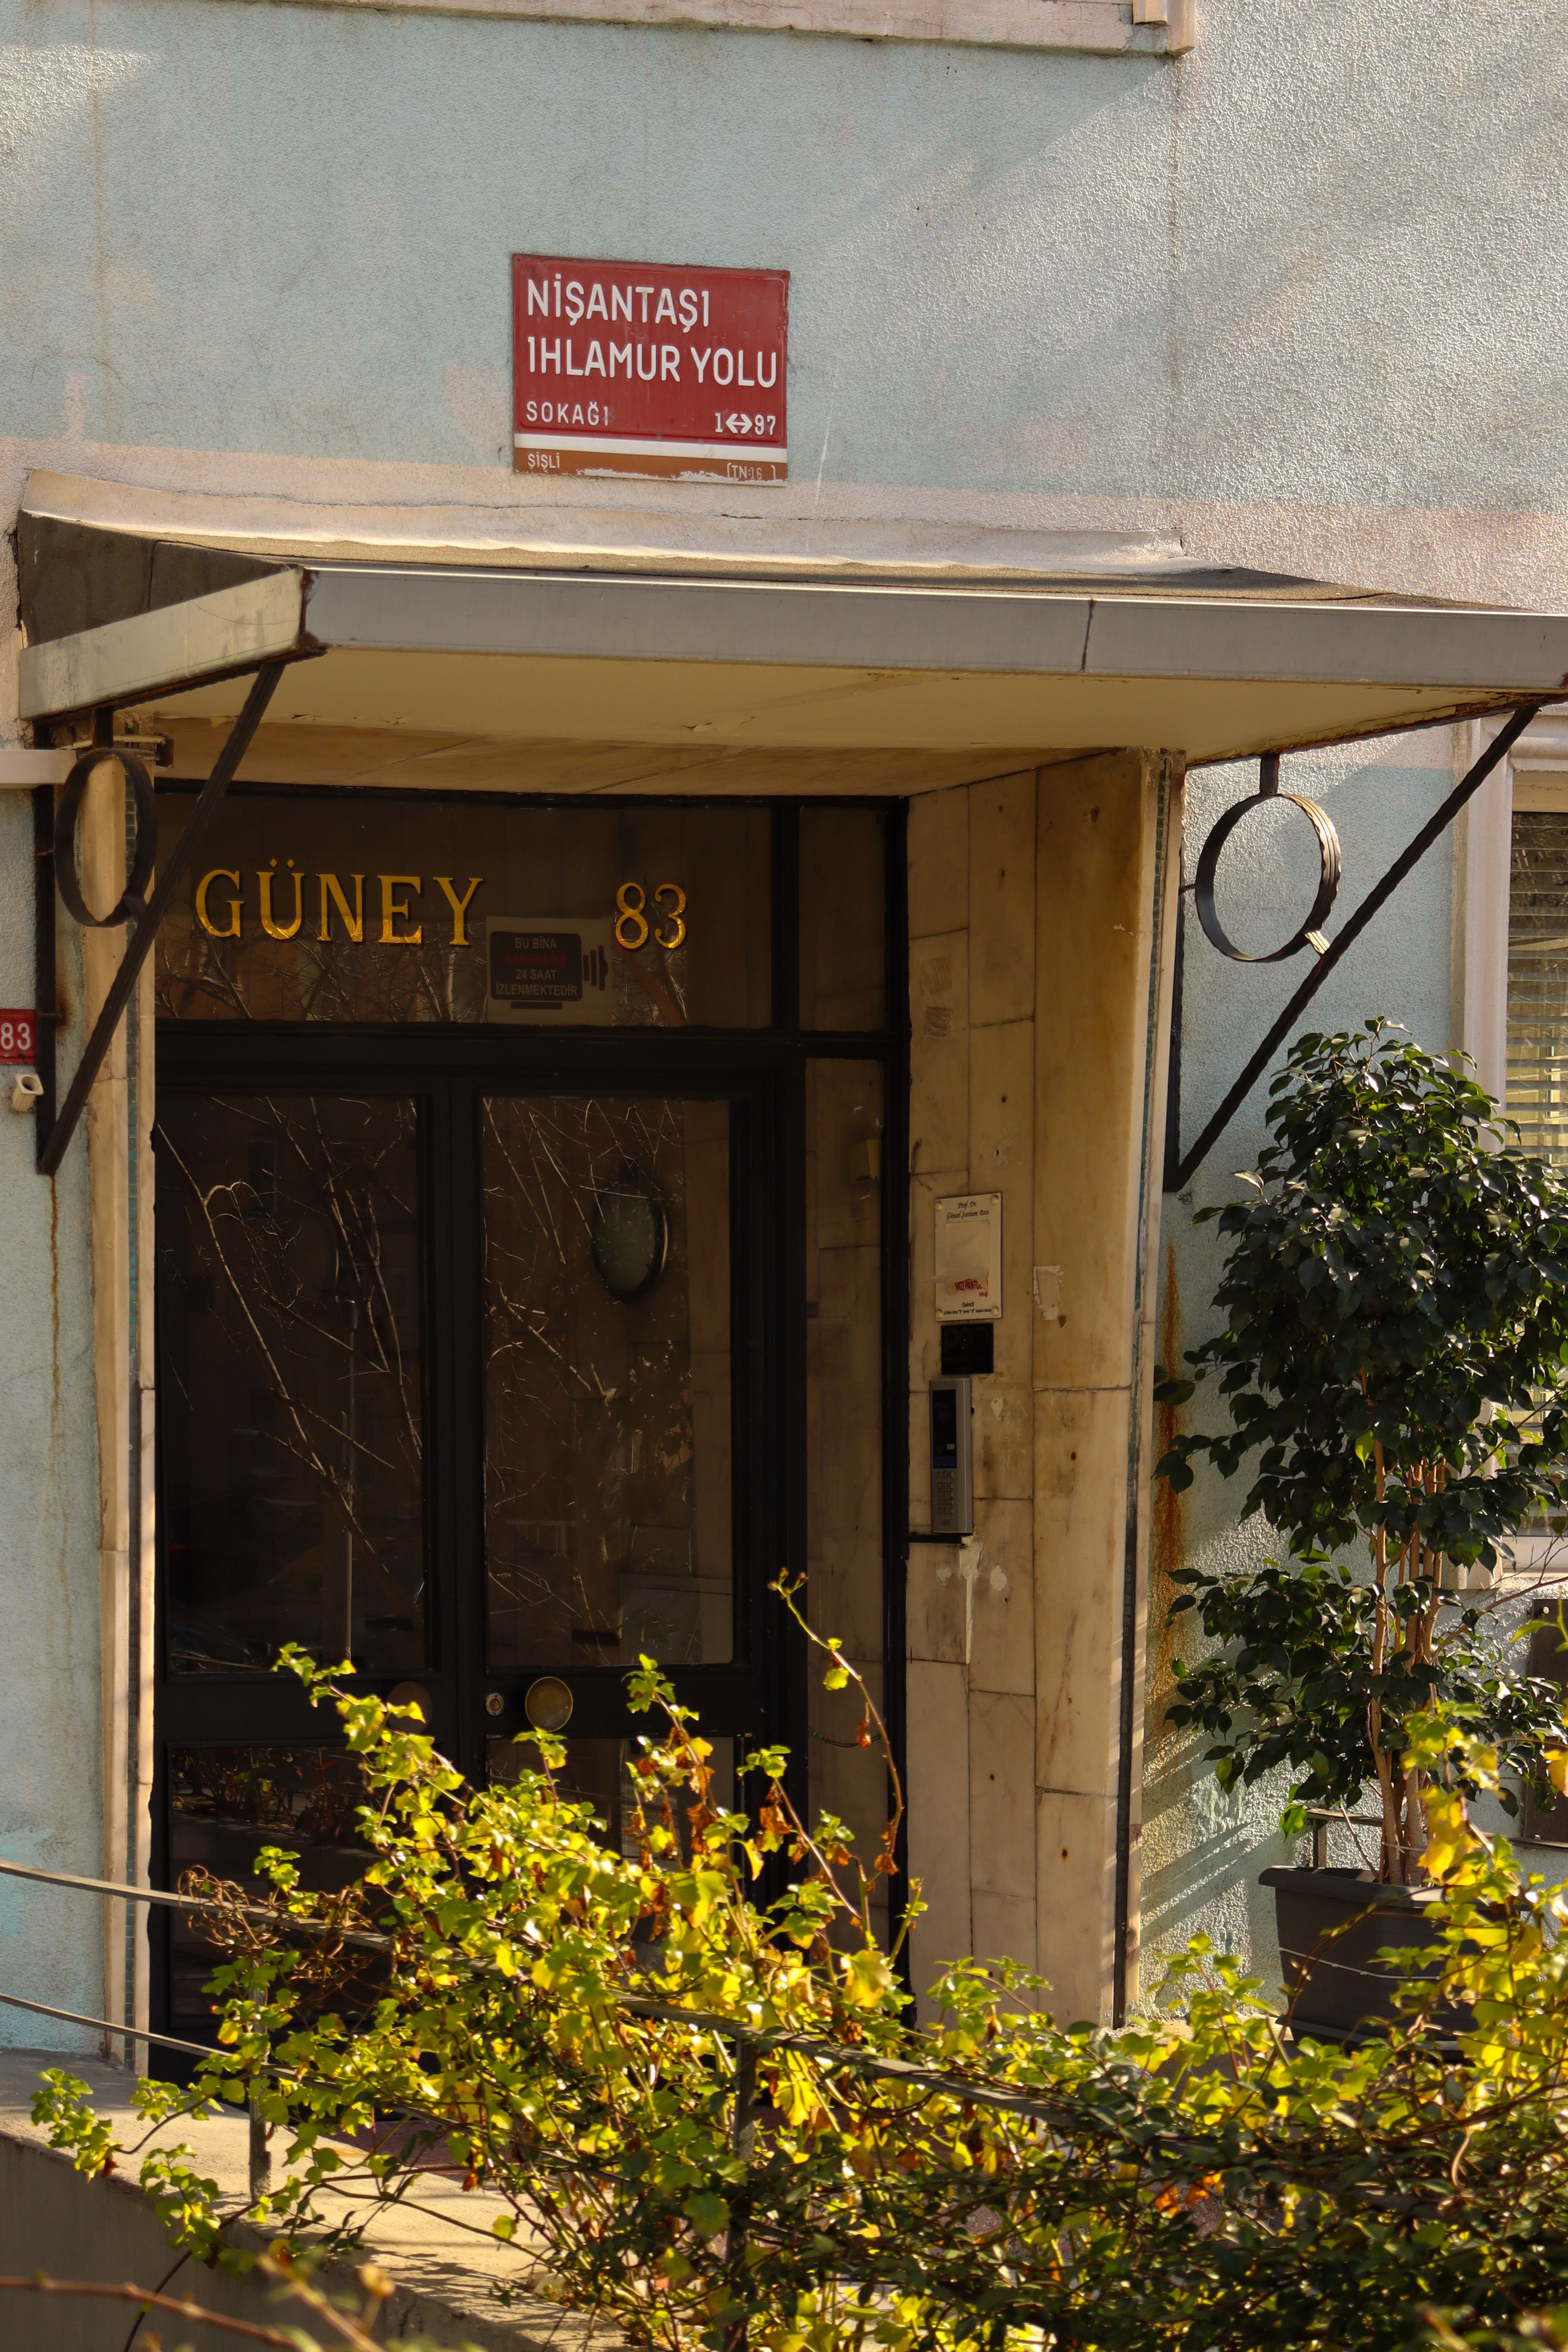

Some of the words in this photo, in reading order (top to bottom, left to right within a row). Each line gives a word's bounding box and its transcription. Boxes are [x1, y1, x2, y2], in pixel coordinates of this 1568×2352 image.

[528, 274, 709, 333] NİŞANTAŞI
[528, 336, 680, 382] IHLAMUR
[690, 347, 777, 388] YOLU
[526, 401, 609, 426] SOKAĞI
[528, 451, 560, 469] ŞİŞLİ
[195, 858, 484, 946] GÜNEY
[613, 881, 688, 949] 83
[515, 937, 529, 949] BU
[532, 936, 557, 949] BİNA
[505, 953, 548, 964] KAMERA
[552, 953, 567, 966] İLE
[516, 969, 527, 979] 24
[531, 969, 557, 980] SAAT
[495, 983, 577, 996] İZLENMEKTEDİR
[0, 1022, 31, 1051] 83
[958, 1201, 969, 1210] Prof.
